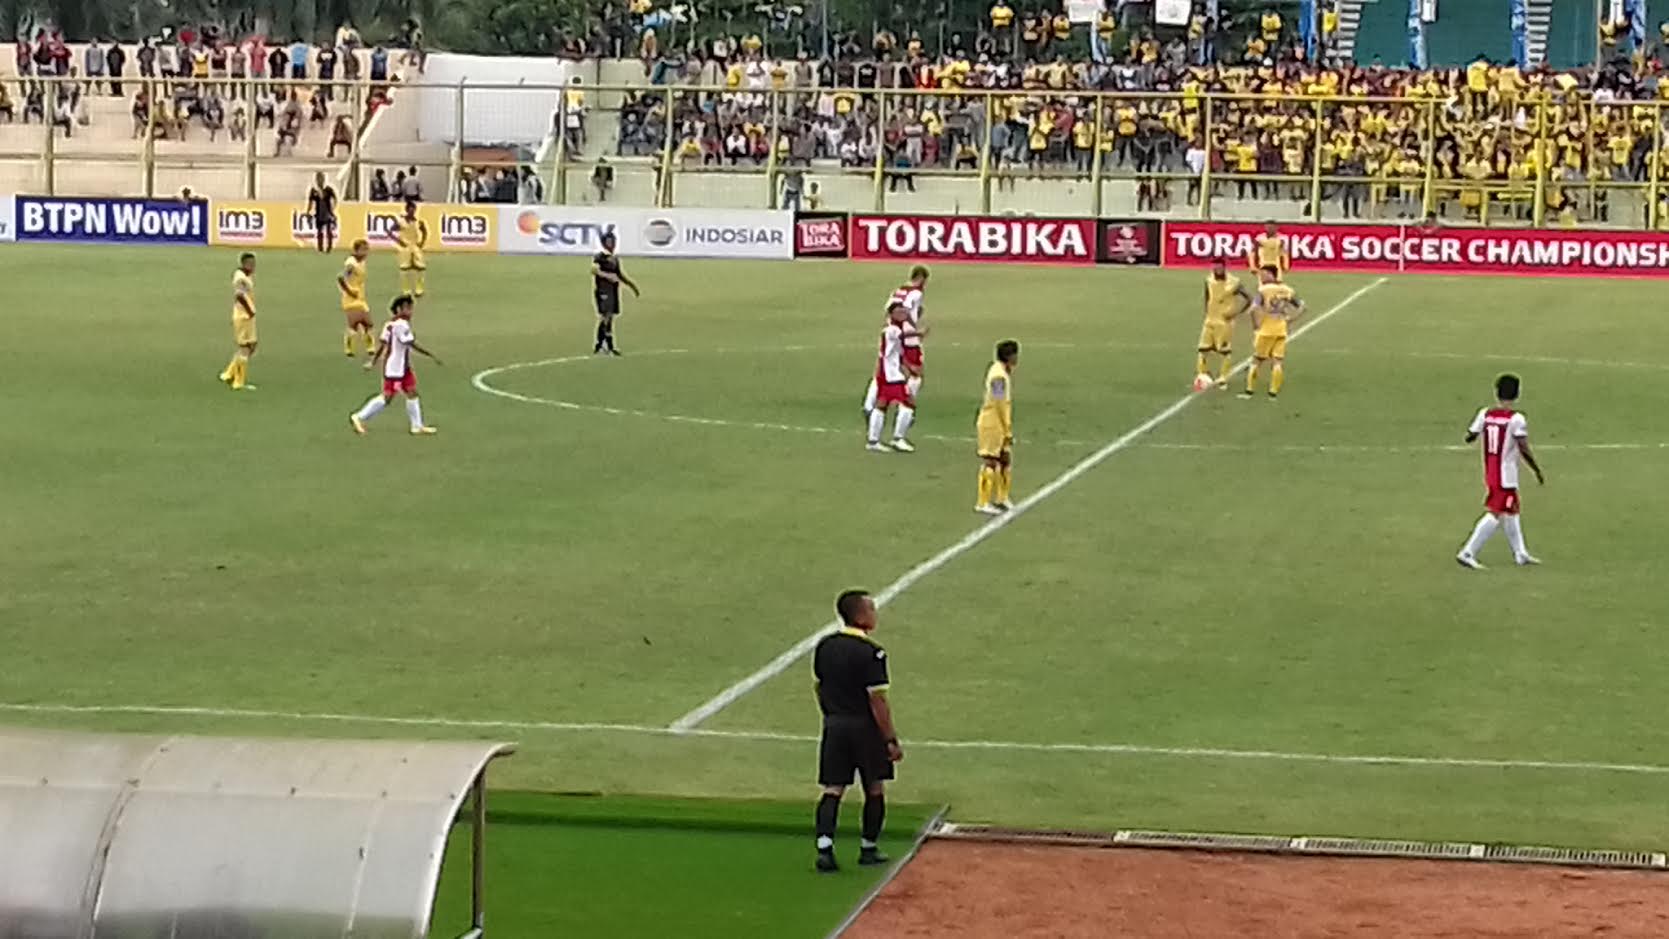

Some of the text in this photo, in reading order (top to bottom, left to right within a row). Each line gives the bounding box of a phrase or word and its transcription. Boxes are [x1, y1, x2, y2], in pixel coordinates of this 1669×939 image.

[23, 201, 107, 234] BTPN
[112, 202, 201, 236] Wow!
[685, 228, 784, 245] INDOSIAR
[858, 219, 1087, 256] TORABIKA
[1341, 235, 1463, 263] SOCCER
